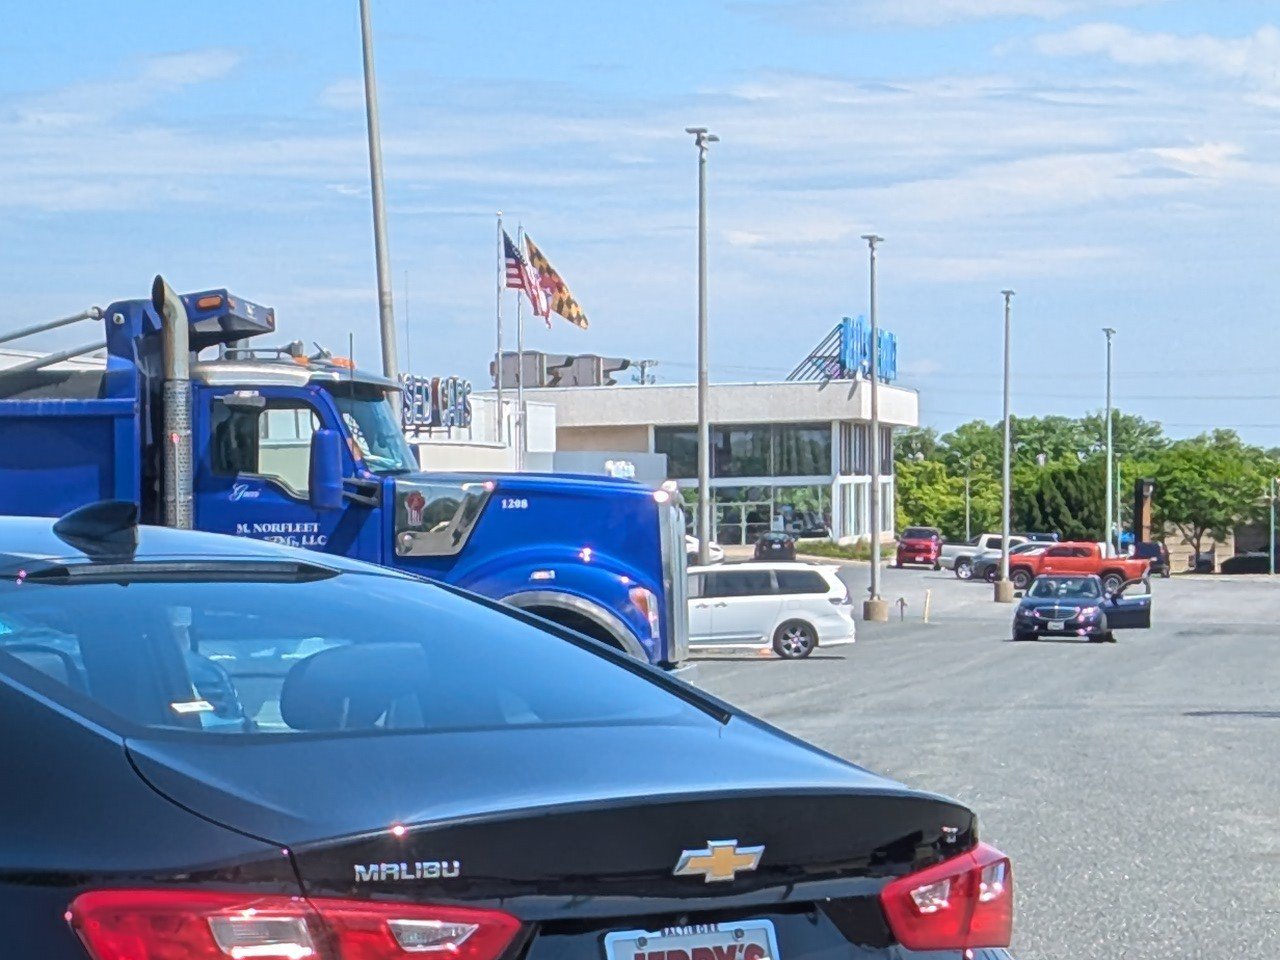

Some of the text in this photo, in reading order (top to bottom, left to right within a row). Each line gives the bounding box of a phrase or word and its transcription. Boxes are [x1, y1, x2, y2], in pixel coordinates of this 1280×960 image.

[399, 373, 431, 425] SED
[253, 522, 319, 533] NORFLEET
[301, 534, 327, 545] LLC
[354, 860, 460, 882] MALIBU
